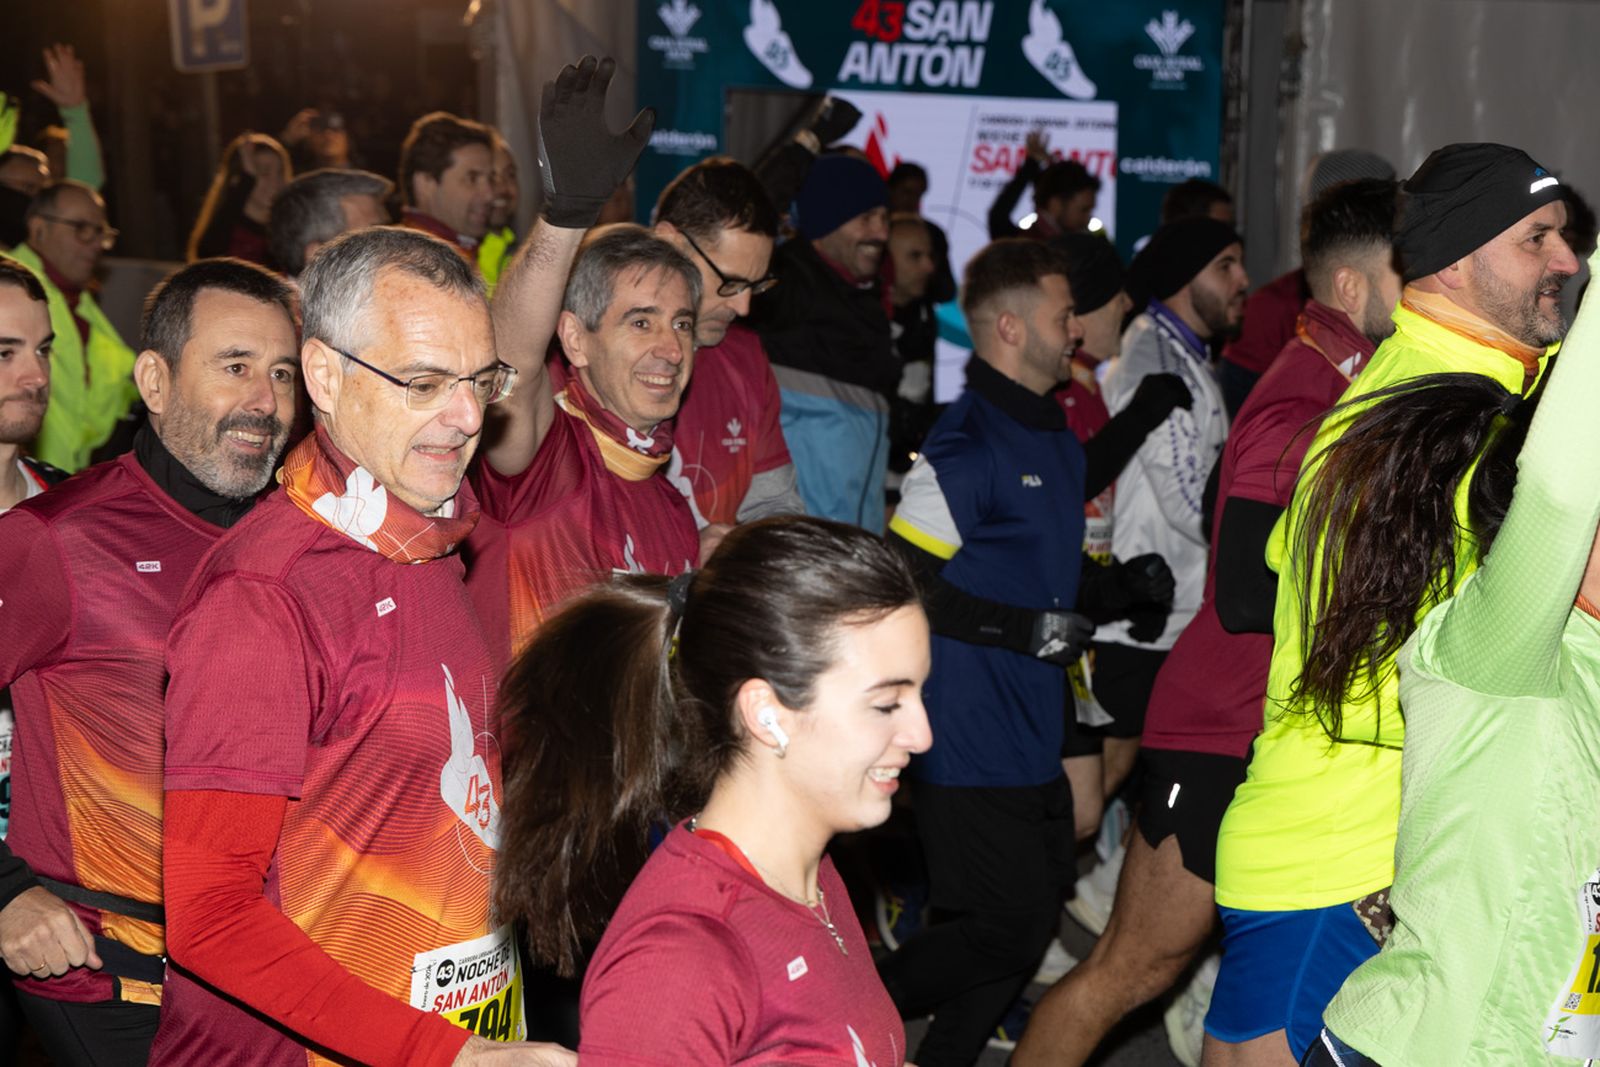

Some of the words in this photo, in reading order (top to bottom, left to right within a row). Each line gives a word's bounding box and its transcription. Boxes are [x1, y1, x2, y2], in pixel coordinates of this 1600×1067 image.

[188, 0, 232, 57] P
[838, 36, 987, 88] ANTÓN
[464, 774, 491, 829] 43
[437, 964, 455, 981] 43
[456, 951, 501, 983] NOCHE
[432, 987, 467, 1013] SAN
